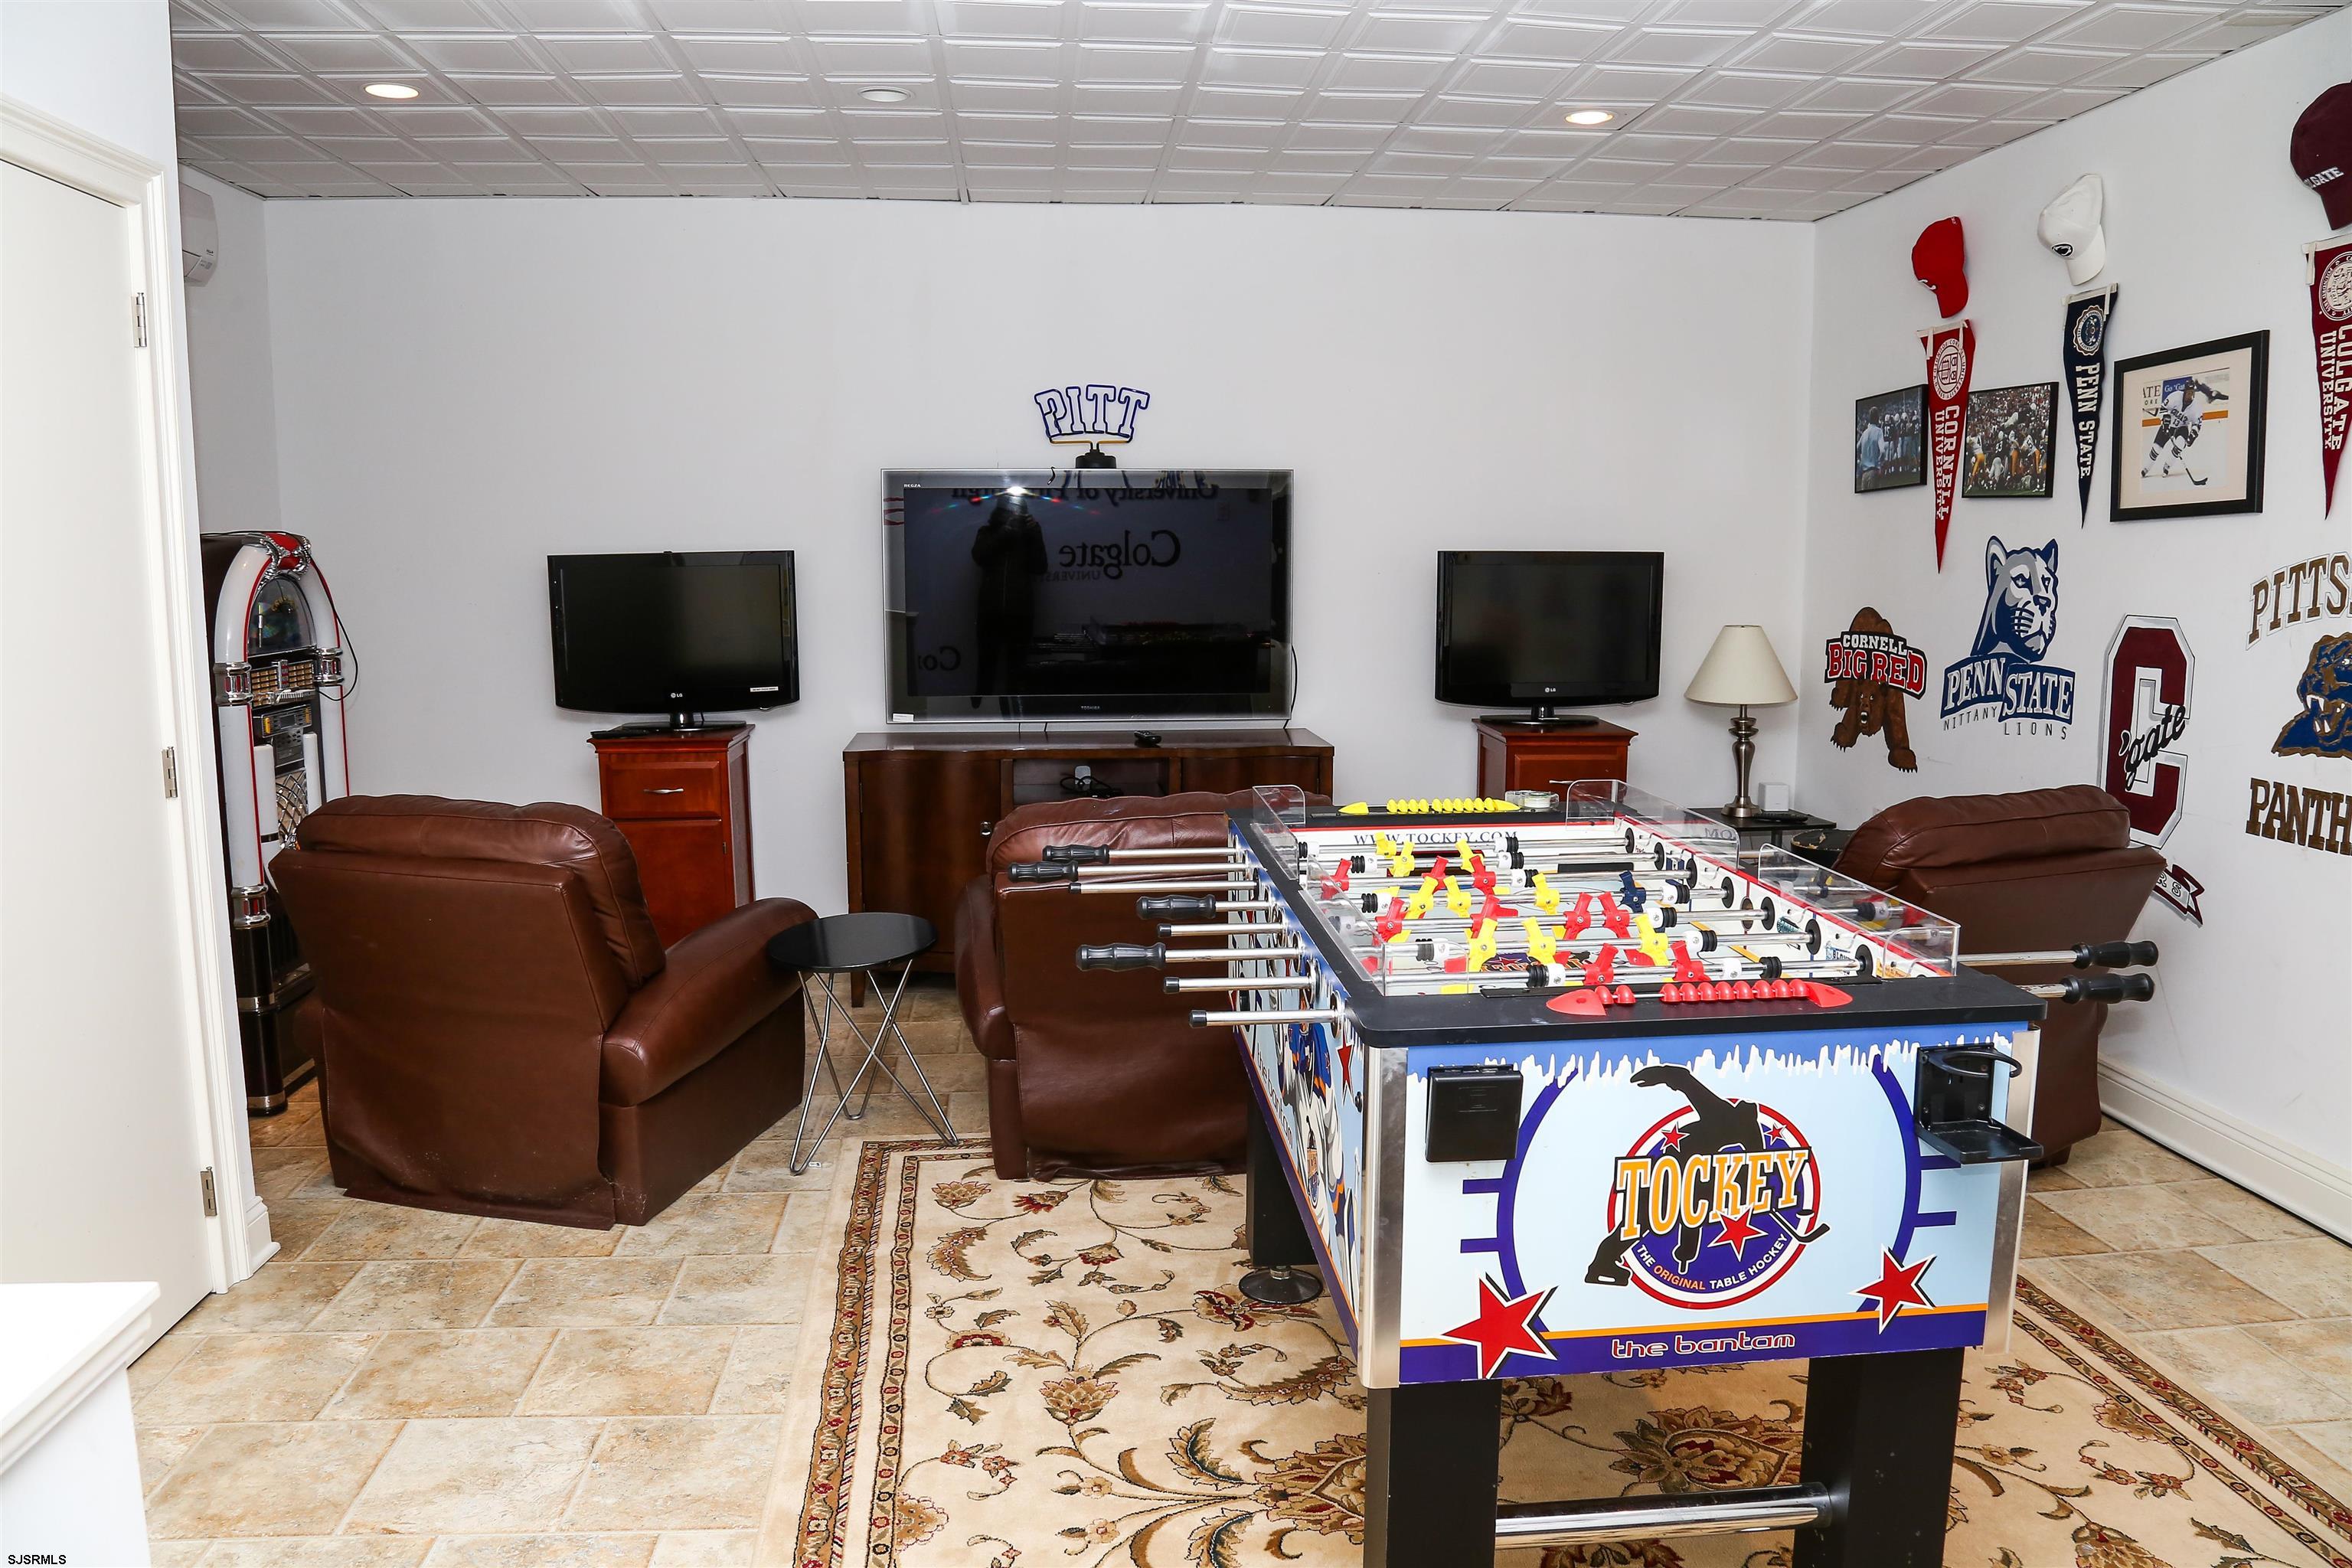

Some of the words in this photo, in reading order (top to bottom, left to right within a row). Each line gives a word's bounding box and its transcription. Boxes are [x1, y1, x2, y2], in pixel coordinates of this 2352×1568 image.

[1034, 384, 1150, 439] PITT
[2076, 363, 2100, 413] PENN
[1935, 409, 1945, 520] UNIVERSITY
[1940, 405, 1960, 519] CORNELL
[2079, 420, 2096, 479] STATE
[2247, 552, 2352, 650] PITTS
[1828, 642, 1867, 680] BIG
[1870, 649, 1925, 695] RED
[1843, 634, 1908, 656] CORNELL
[1944, 658, 2007, 710] PENN
[2002, 671, 2073, 720] STATE
[1943, 706, 1998, 731] NITTANY
[2004, 722, 2067, 740] LIONS
[2246, 777, 2352, 857] PANTH
[1615, 1148, 1809, 1242] TOCKEY
[1637, 1244, 1656, 1268] THE
[1653, 1265, 1707, 1291] ORIGINAL
[1709, 1271, 1747, 1290] TABLE
[1749, 1233, 1788, 1276] HOCKEY
[1611, 1338, 1668, 1359] the
[1674, 1330, 1795, 1355] bantam
